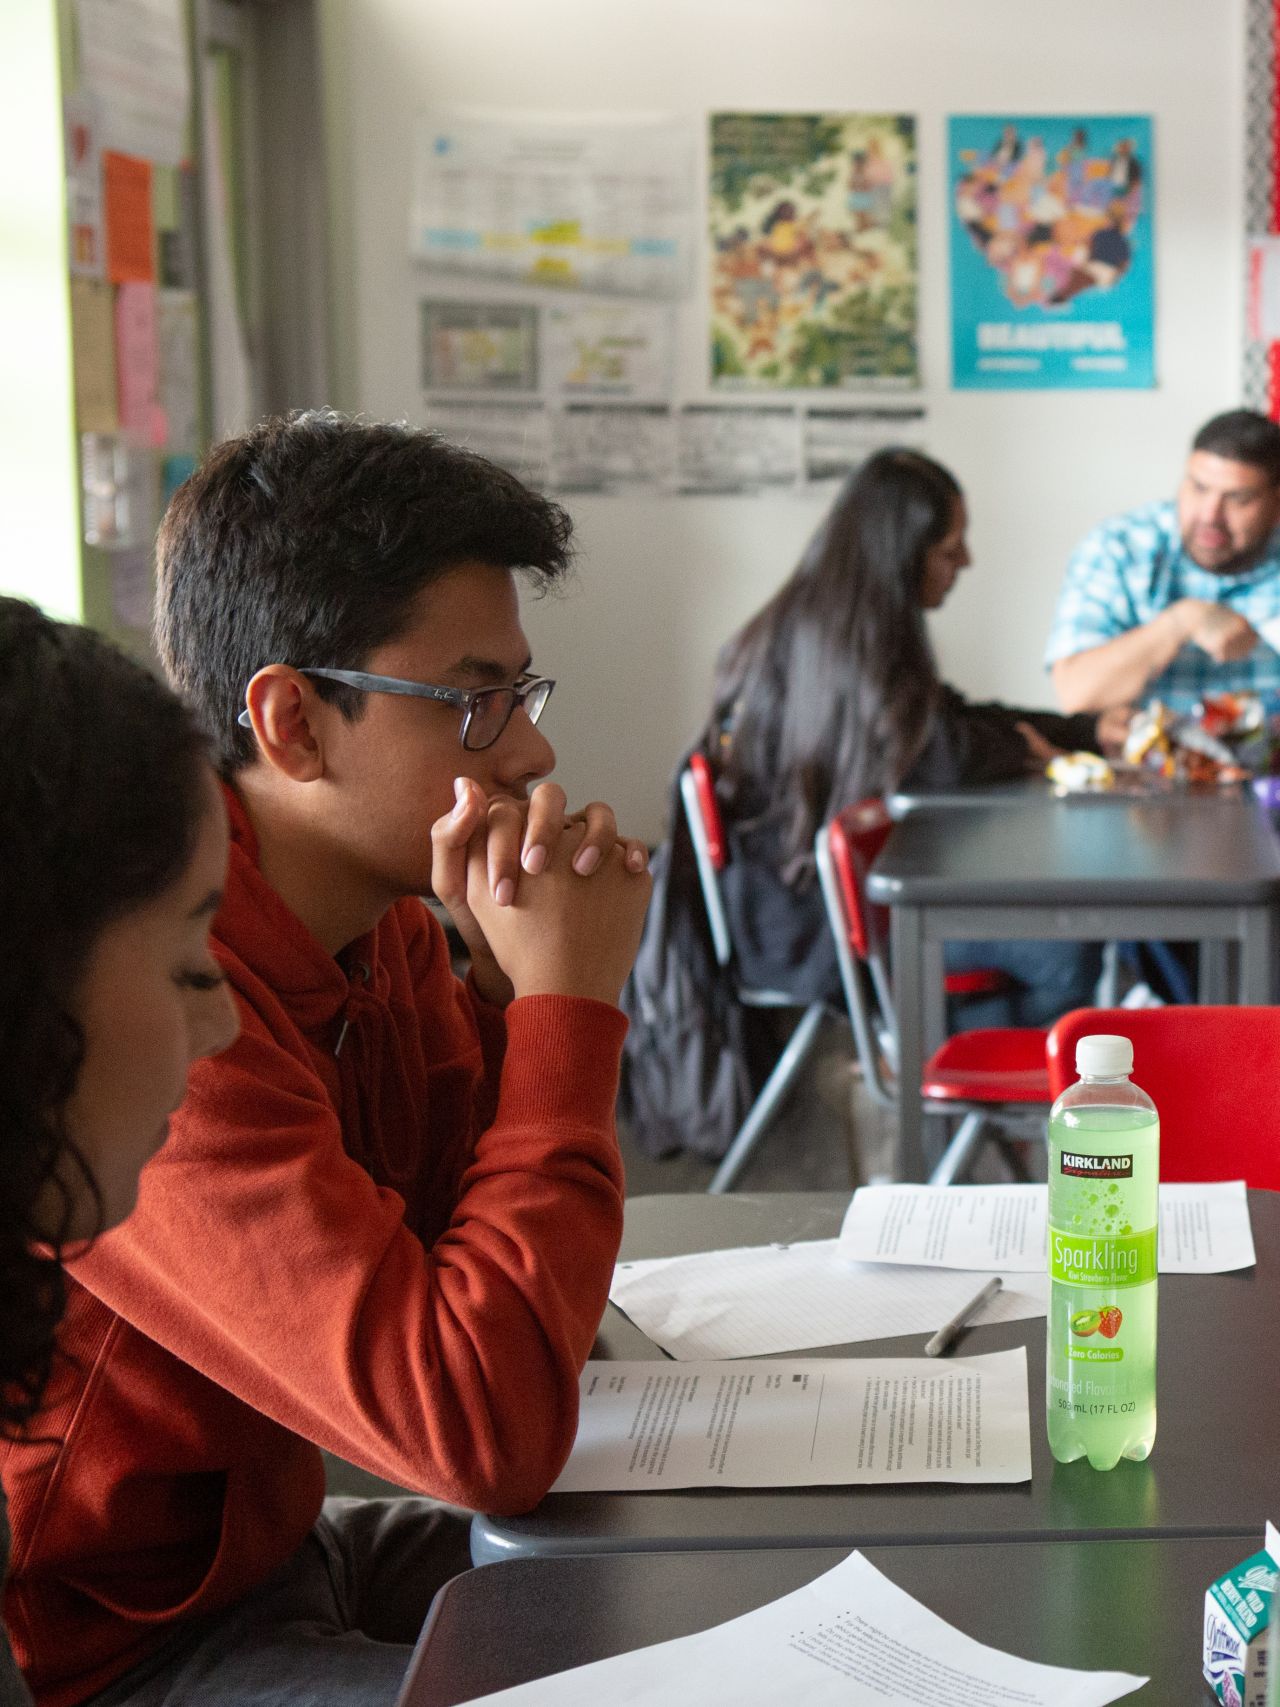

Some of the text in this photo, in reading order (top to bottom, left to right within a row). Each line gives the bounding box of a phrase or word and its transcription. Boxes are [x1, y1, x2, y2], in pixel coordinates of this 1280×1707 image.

[1063, 1153, 1131, 1170] KIRKLAND
[1055, 1237, 1138, 1274] Sparkling
[1068, 1269, 1128, 1283] Kiwi Strawberry Flavor
[1069, 1347, 1120, 1360] Zero Calories
[1073, 1404, 1087, 1413] mL
[1089, 1403, 1105, 1415] (17
[1107, 1404, 1118, 1414] FL
[1120, 1401, 1136, 1413] OZ)
